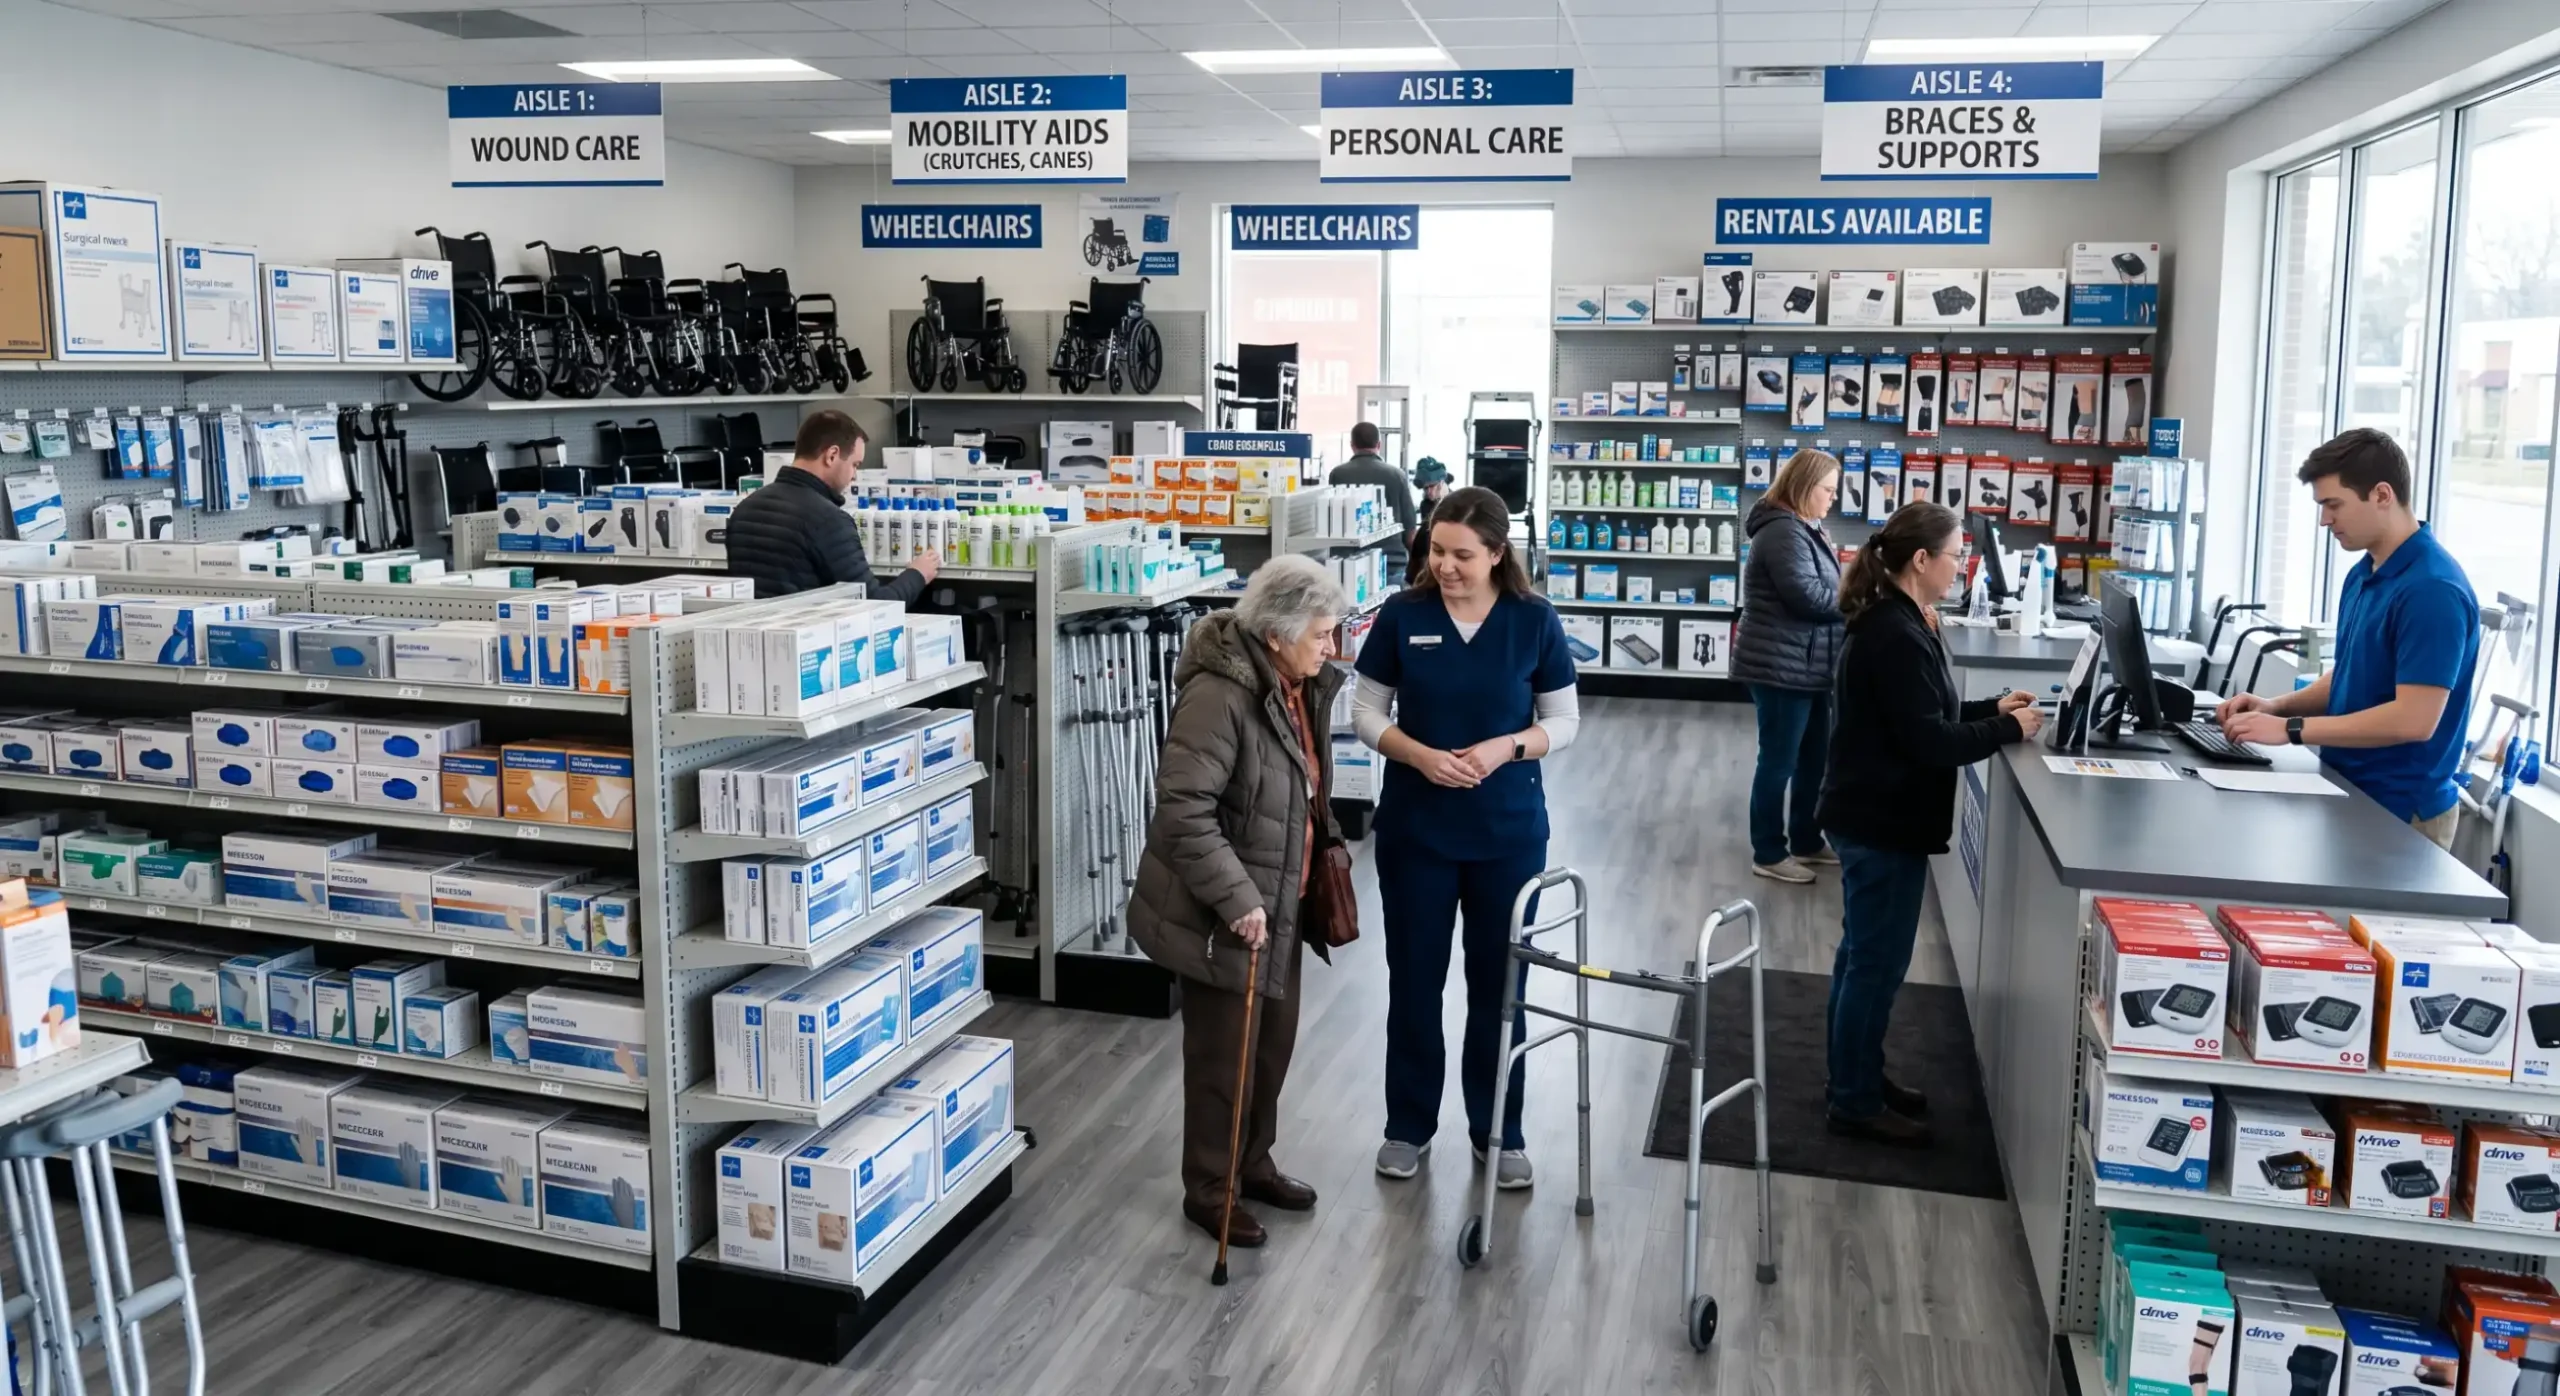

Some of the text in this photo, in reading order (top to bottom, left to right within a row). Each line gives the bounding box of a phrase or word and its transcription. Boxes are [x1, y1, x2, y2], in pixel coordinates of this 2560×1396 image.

[964, 83, 1052, 106] AISLE 2:
[1398, 77, 1493, 101] AISLE 3:
[1911, 70, 2012, 95] AISLE 4:
[514, 89, 596, 112] AISLE 1:
[908, 117, 1109, 148] MOBILITY AIDS
[1886, 106, 2035, 135] BRACES &
[471, 135, 641, 163] WOUND CARE
[1329, 126, 1564, 156] PERSONAL CARE
[923, 150, 1094, 173] (CRUTCHES, CANES)
[1878, 140, 2040, 169] SUPPORTS
[869, 212, 1034, 241] WHEELCHAIRS
[1237, 212, 1413, 242] WHEELCHAIRS
[1724, 207, 1984, 236] RENTALS AVAILABLE
[63, 231, 101, 247] Surgical
[410, 265, 440, 282] drive
[2484, 1147, 2525, 1162] drive
[2140, 1306, 2179, 1321] drive
[2245, 1326, 2286, 1342] drive
[2357, 1351, 2401, 1368] drive
